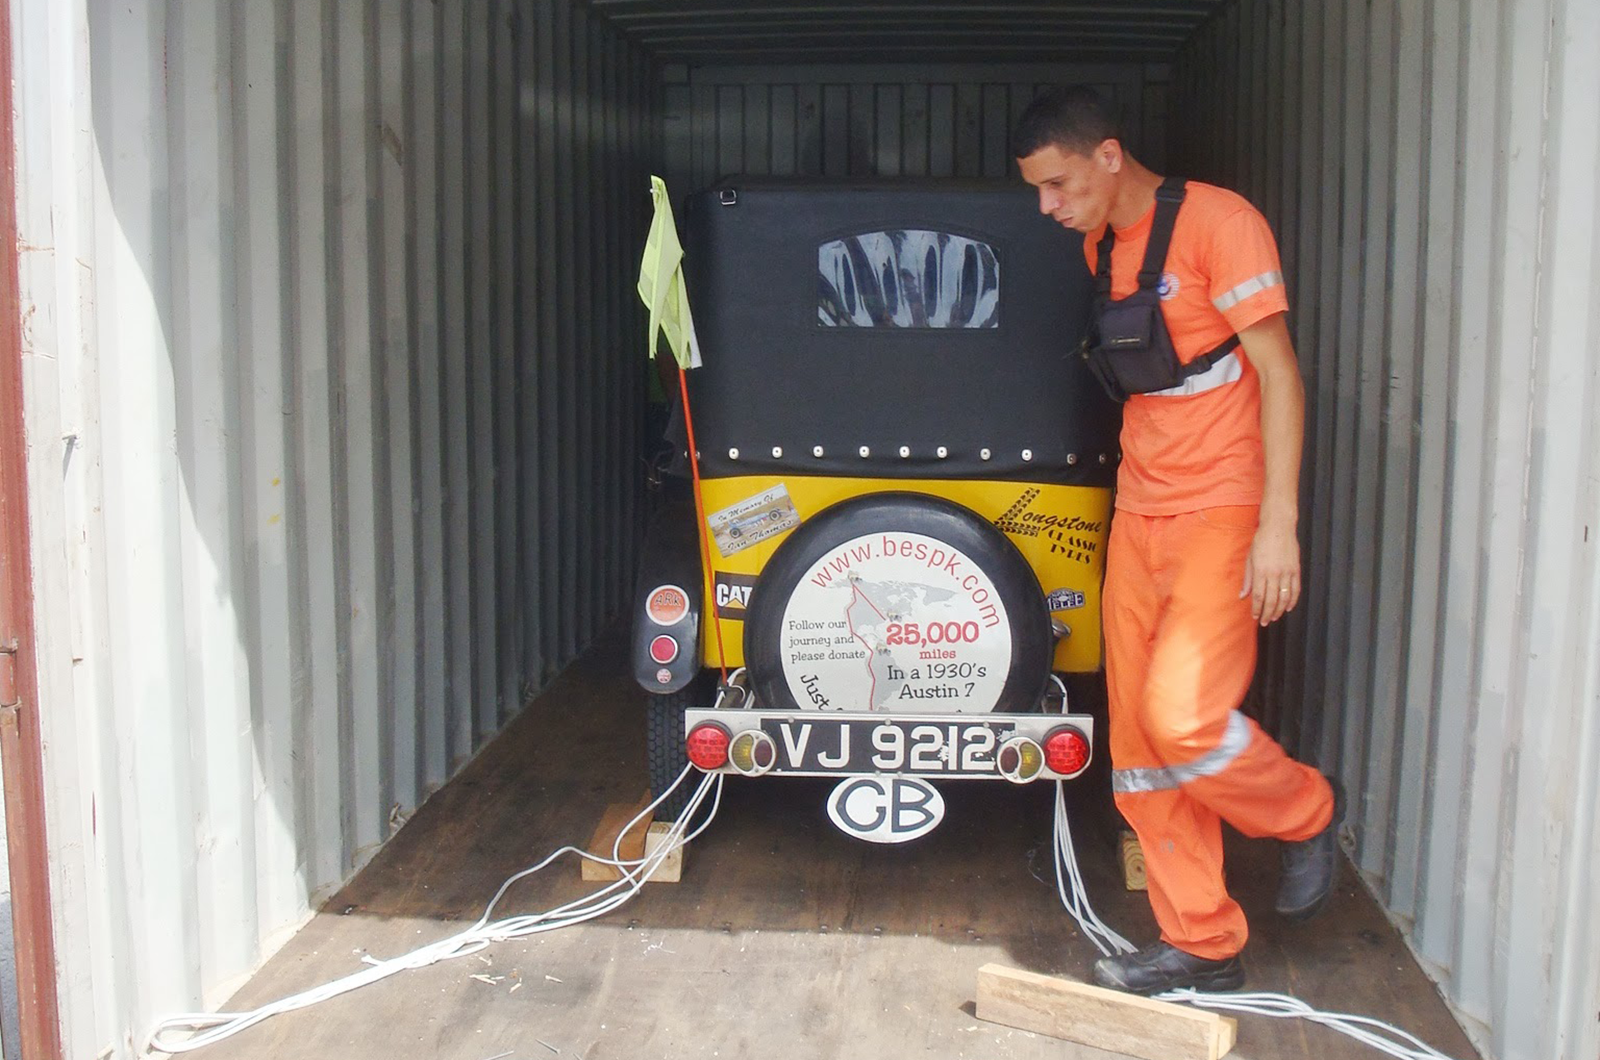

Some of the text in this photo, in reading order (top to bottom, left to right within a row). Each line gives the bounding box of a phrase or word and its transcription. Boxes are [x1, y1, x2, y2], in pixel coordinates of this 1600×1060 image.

[993, 487, 1102, 537] Longstone
[1048, 529, 1097, 553] CLASSIC
[1050, 543, 1090, 564] TYRES
[811, 536, 1000, 629] www.bespk.com
[716, 583, 753, 608] CAT
[788, 620, 847, 631] Follow our
[886, 620, 980, 647] 25,000
[788, 634, 855, 648] journey and
[791, 650, 866, 664] please donate
[919, 649, 957, 660] miles
[887, 662, 987, 680] In a 1930's
[800, 674, 830, 710] Just
[898, 682, 976, 700] Austin 7
[871, 724, 996, 771] 9212
[835, 778, 935, 834] GB
